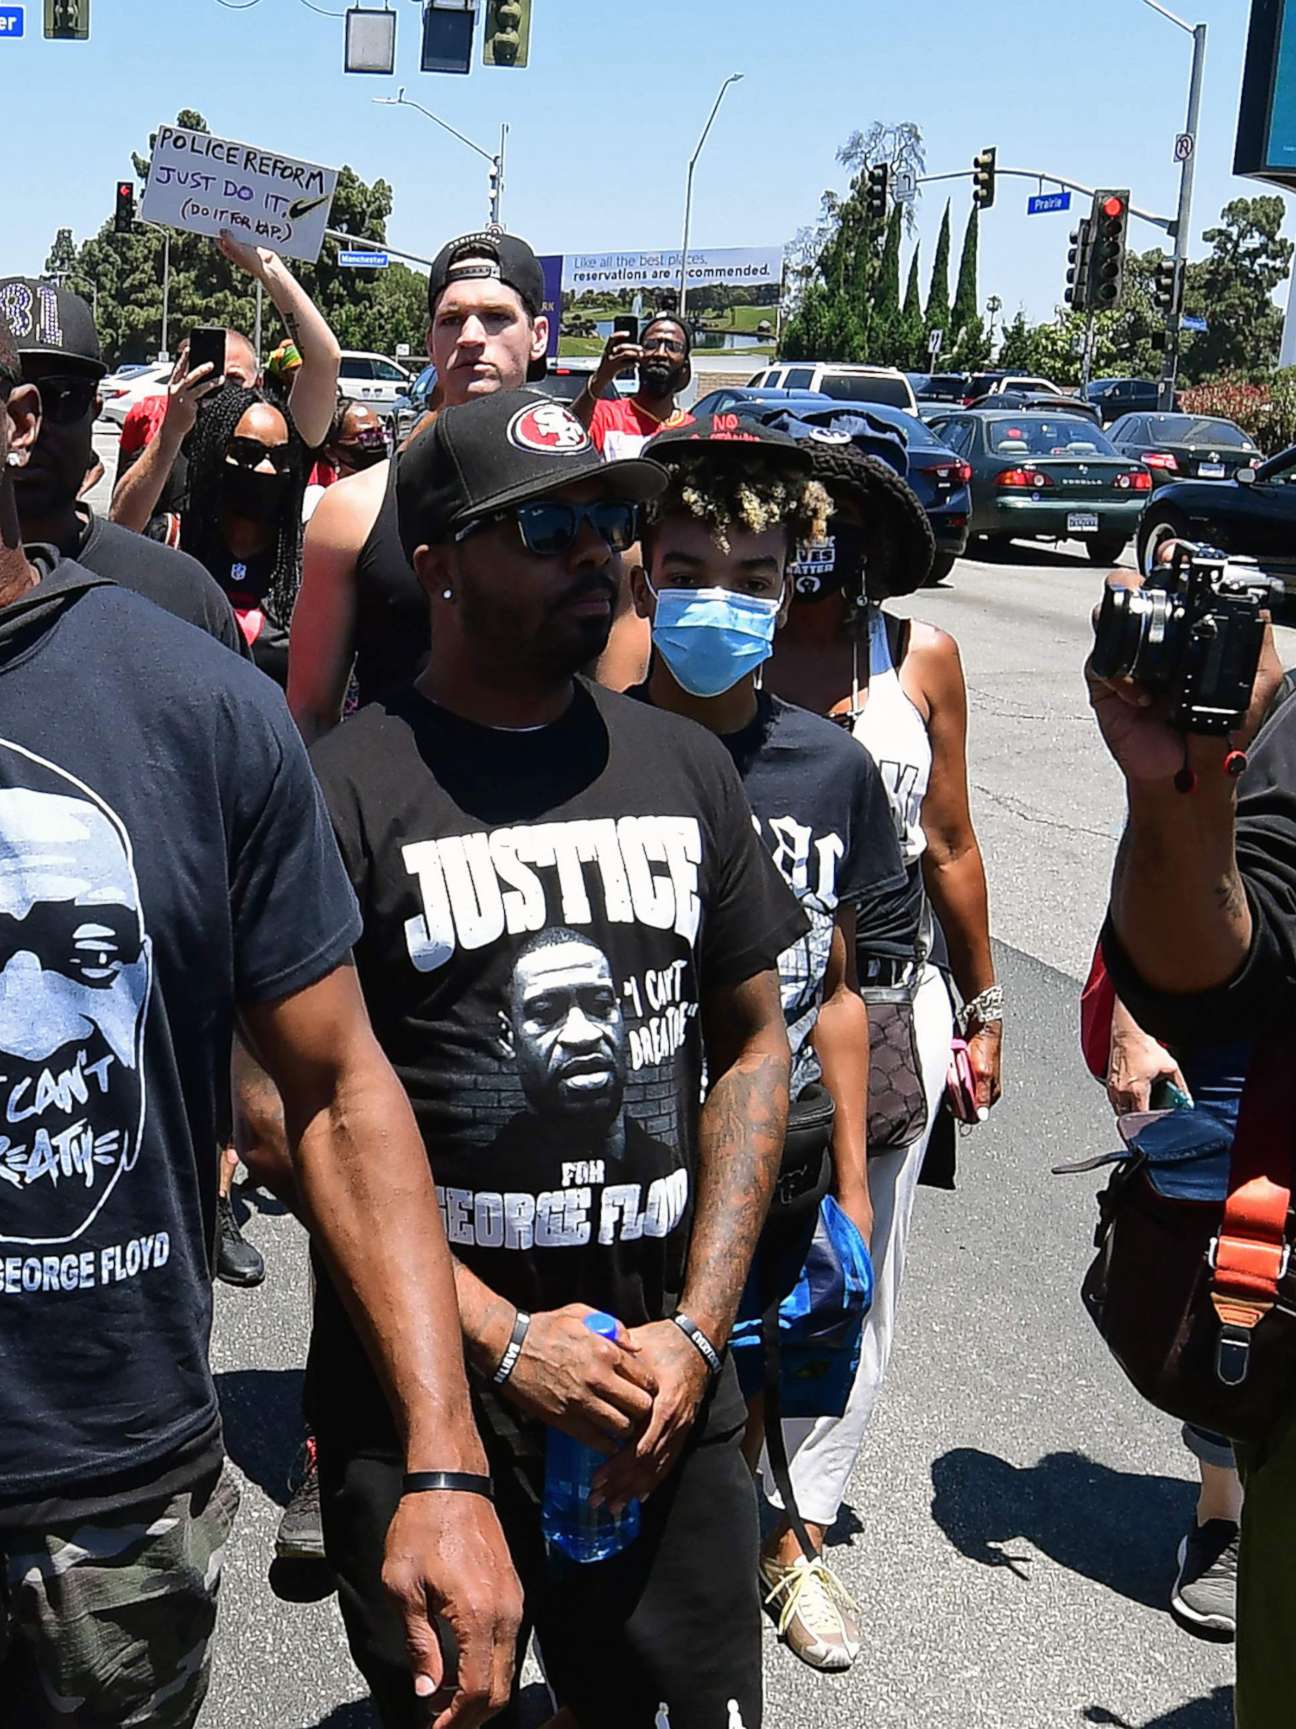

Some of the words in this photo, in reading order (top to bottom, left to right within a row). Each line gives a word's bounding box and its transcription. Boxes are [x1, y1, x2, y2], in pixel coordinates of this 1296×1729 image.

[160, 128, 240, 165] POLICE
[243, 150, 324, 194] REFORM
[156, 166, 216, 191] JUST
[223, 180, 254, 200] DO
[181, 198, 209, 220] (DO
[212, 210, 229, 221] IT
[230, 213, 252, 230] FOR
[1035, 198, 1062, 211] Prairie
[573, 268, 647, 282] reservations
[651, 269, 671, 279] are
[675, 263, 770, 279] rcommended.
[574, 256, 596, 269] Like
[600, 255, 613, 267] all
[616, 254, 636, 267] the
[639, 254, 664, 267] best
[713, 414, 739, 430] NO
[401, 815, 702, 972] JUSTICE
[6, 1049, 115, 1123] CAN'T
[100, 1231, 170, 1285] FLOYD
